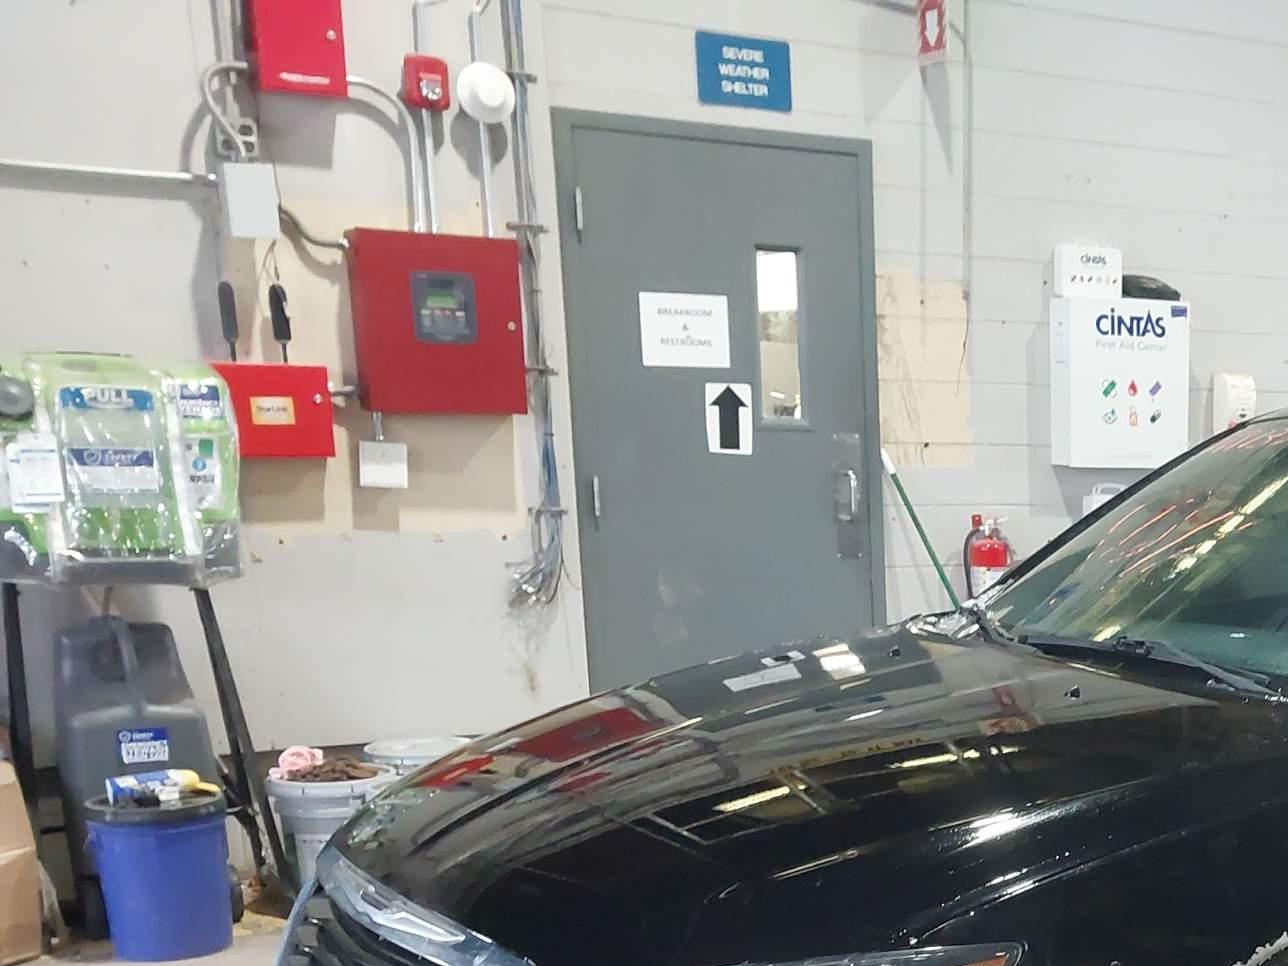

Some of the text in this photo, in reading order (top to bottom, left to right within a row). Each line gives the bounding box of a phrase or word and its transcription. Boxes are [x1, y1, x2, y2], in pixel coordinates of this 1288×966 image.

[722, 46, 764, 63] SEVERE
[718, 63, 769, 80] WEATHER
[721, 80, 768, 96] SHELTER
[657, 307, 712, 317] BREAKROOM
[660, 337, 712, 347] RESTROOMS
[1096, 340, 1168, 352] First Aid Center
